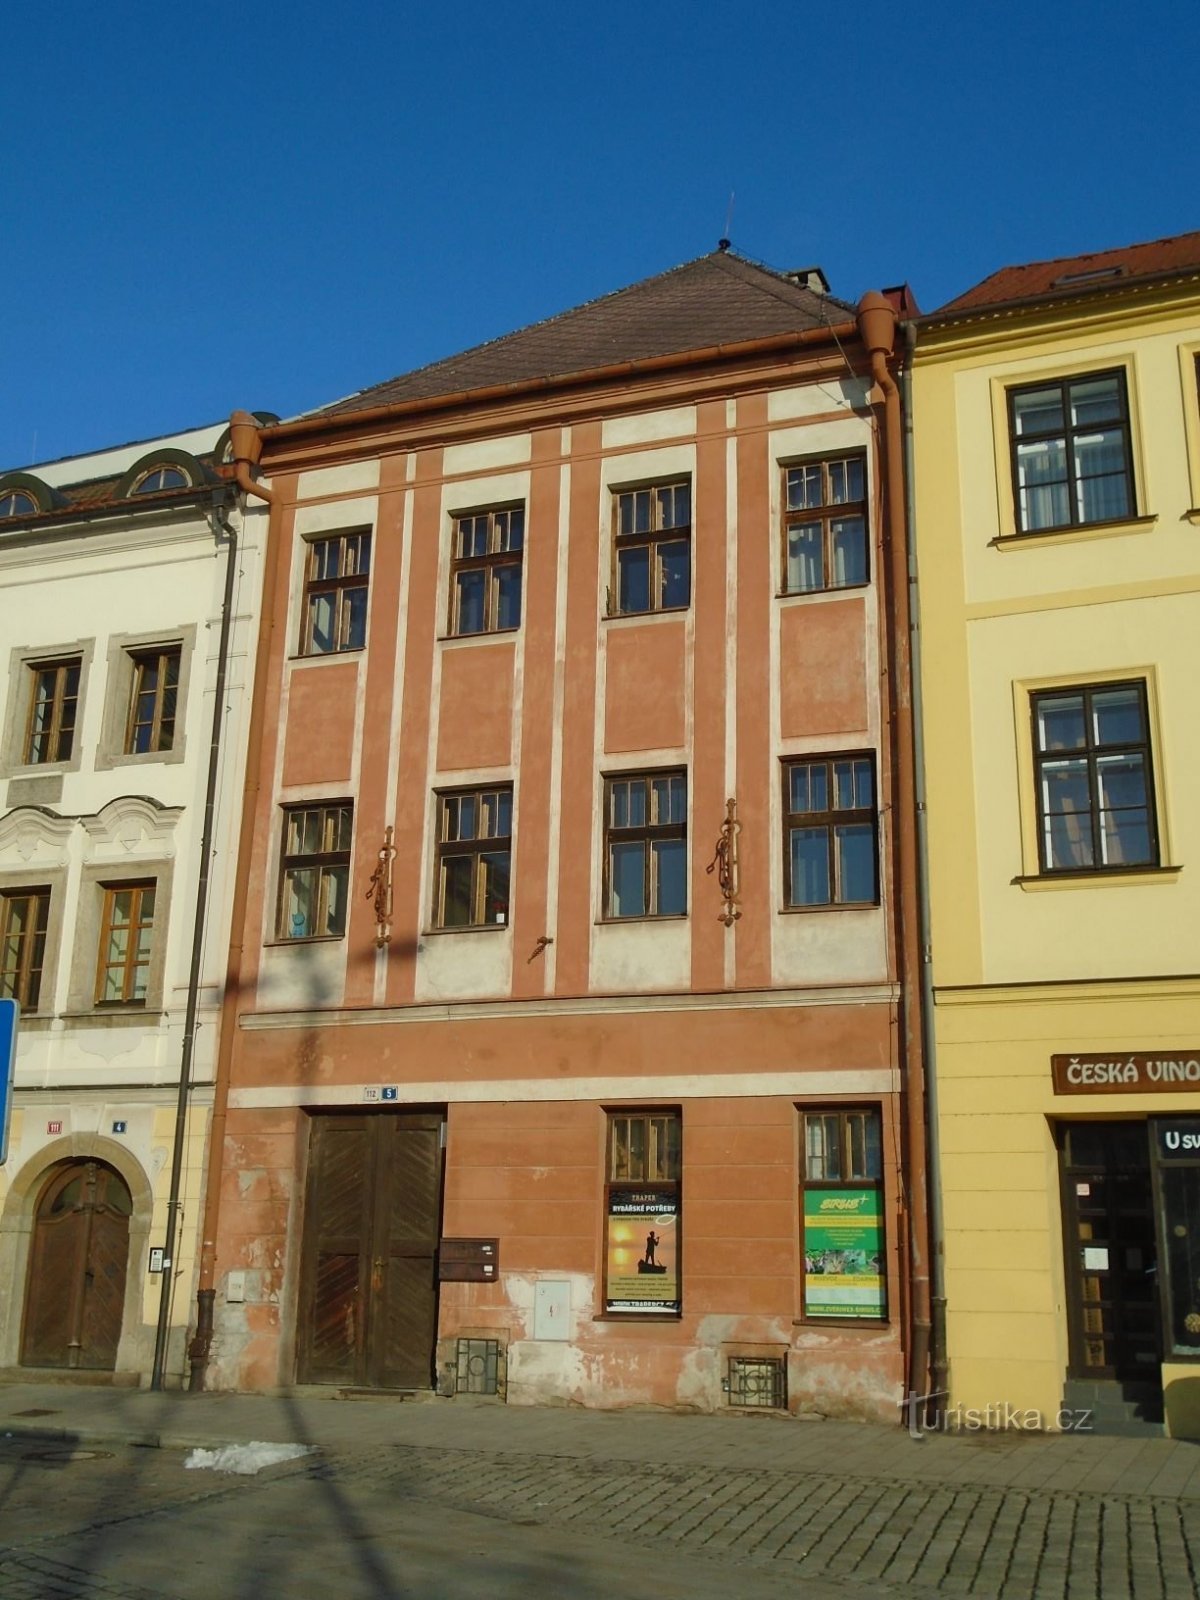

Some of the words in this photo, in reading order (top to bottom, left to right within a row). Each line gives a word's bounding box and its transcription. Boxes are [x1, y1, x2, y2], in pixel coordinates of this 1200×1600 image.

[1066, 1057, 1139, 1084] ČESKÁ
[387, 1088, 392, 1098] 5
[1165, 1131, 1180, 1150] U
[612, 1204, 645, 1212] RYBÁŘSKÉ
[645, 1203, 676, 1213] POTŘEBY
